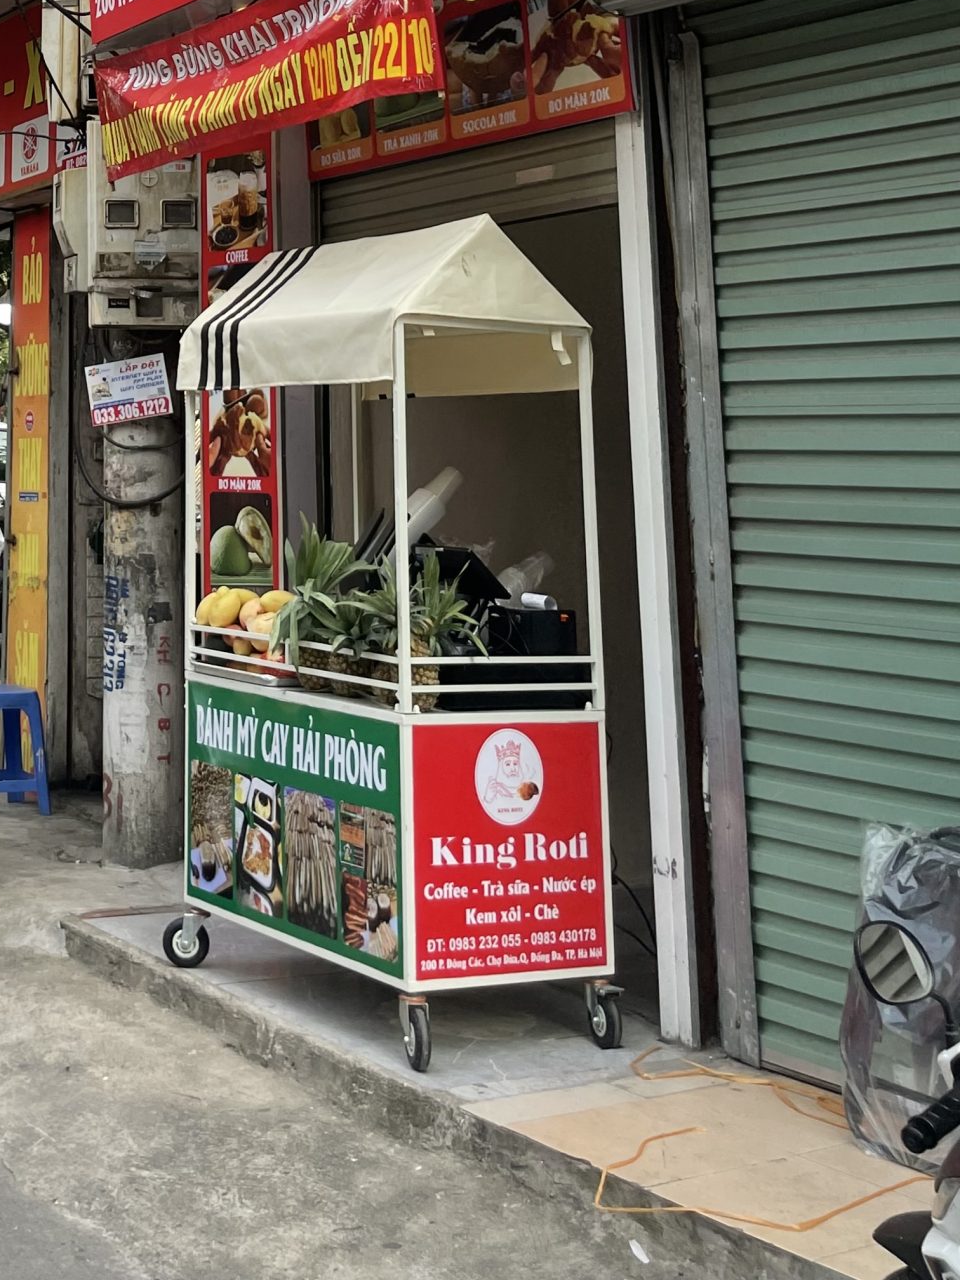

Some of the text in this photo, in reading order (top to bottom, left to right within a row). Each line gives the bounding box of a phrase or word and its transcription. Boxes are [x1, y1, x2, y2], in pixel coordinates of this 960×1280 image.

[220, 19, 277, 64] KHAI
[23, 38, 48, 110] X
[199, 78, 244, 134] BÁNH
[304, 41, 338, 101] 12/10
[335, 18, 373, 93] ĐẾN
[373, 17, 434, 81] 22/10
[590, 87, 611, 103] 20K
[462, 110, 517, 135] SOCOLA 20K
[225, 249, 249, 264] COFFEE
[22, 236, 43, 305] BẢO
[111, 373, 141, 382] INTERNET
[93, 398, 167, 424] 033.306.1212
[247, 478, 262, 491] 20K
[196, 698, 387, 792] BÁNH MỲ CAY HẢI PHÒNG
[431, 831, 589, 870] King Roti
[424, 875, 596, 900] Coffee Trà sữa Nước ép
[465, 904, 560, 925] Kem xôi Chè
[427, 928, 597, 953] ĐT: 0983 232 055 0983 430178
[421, 959, 436, 970] 200
